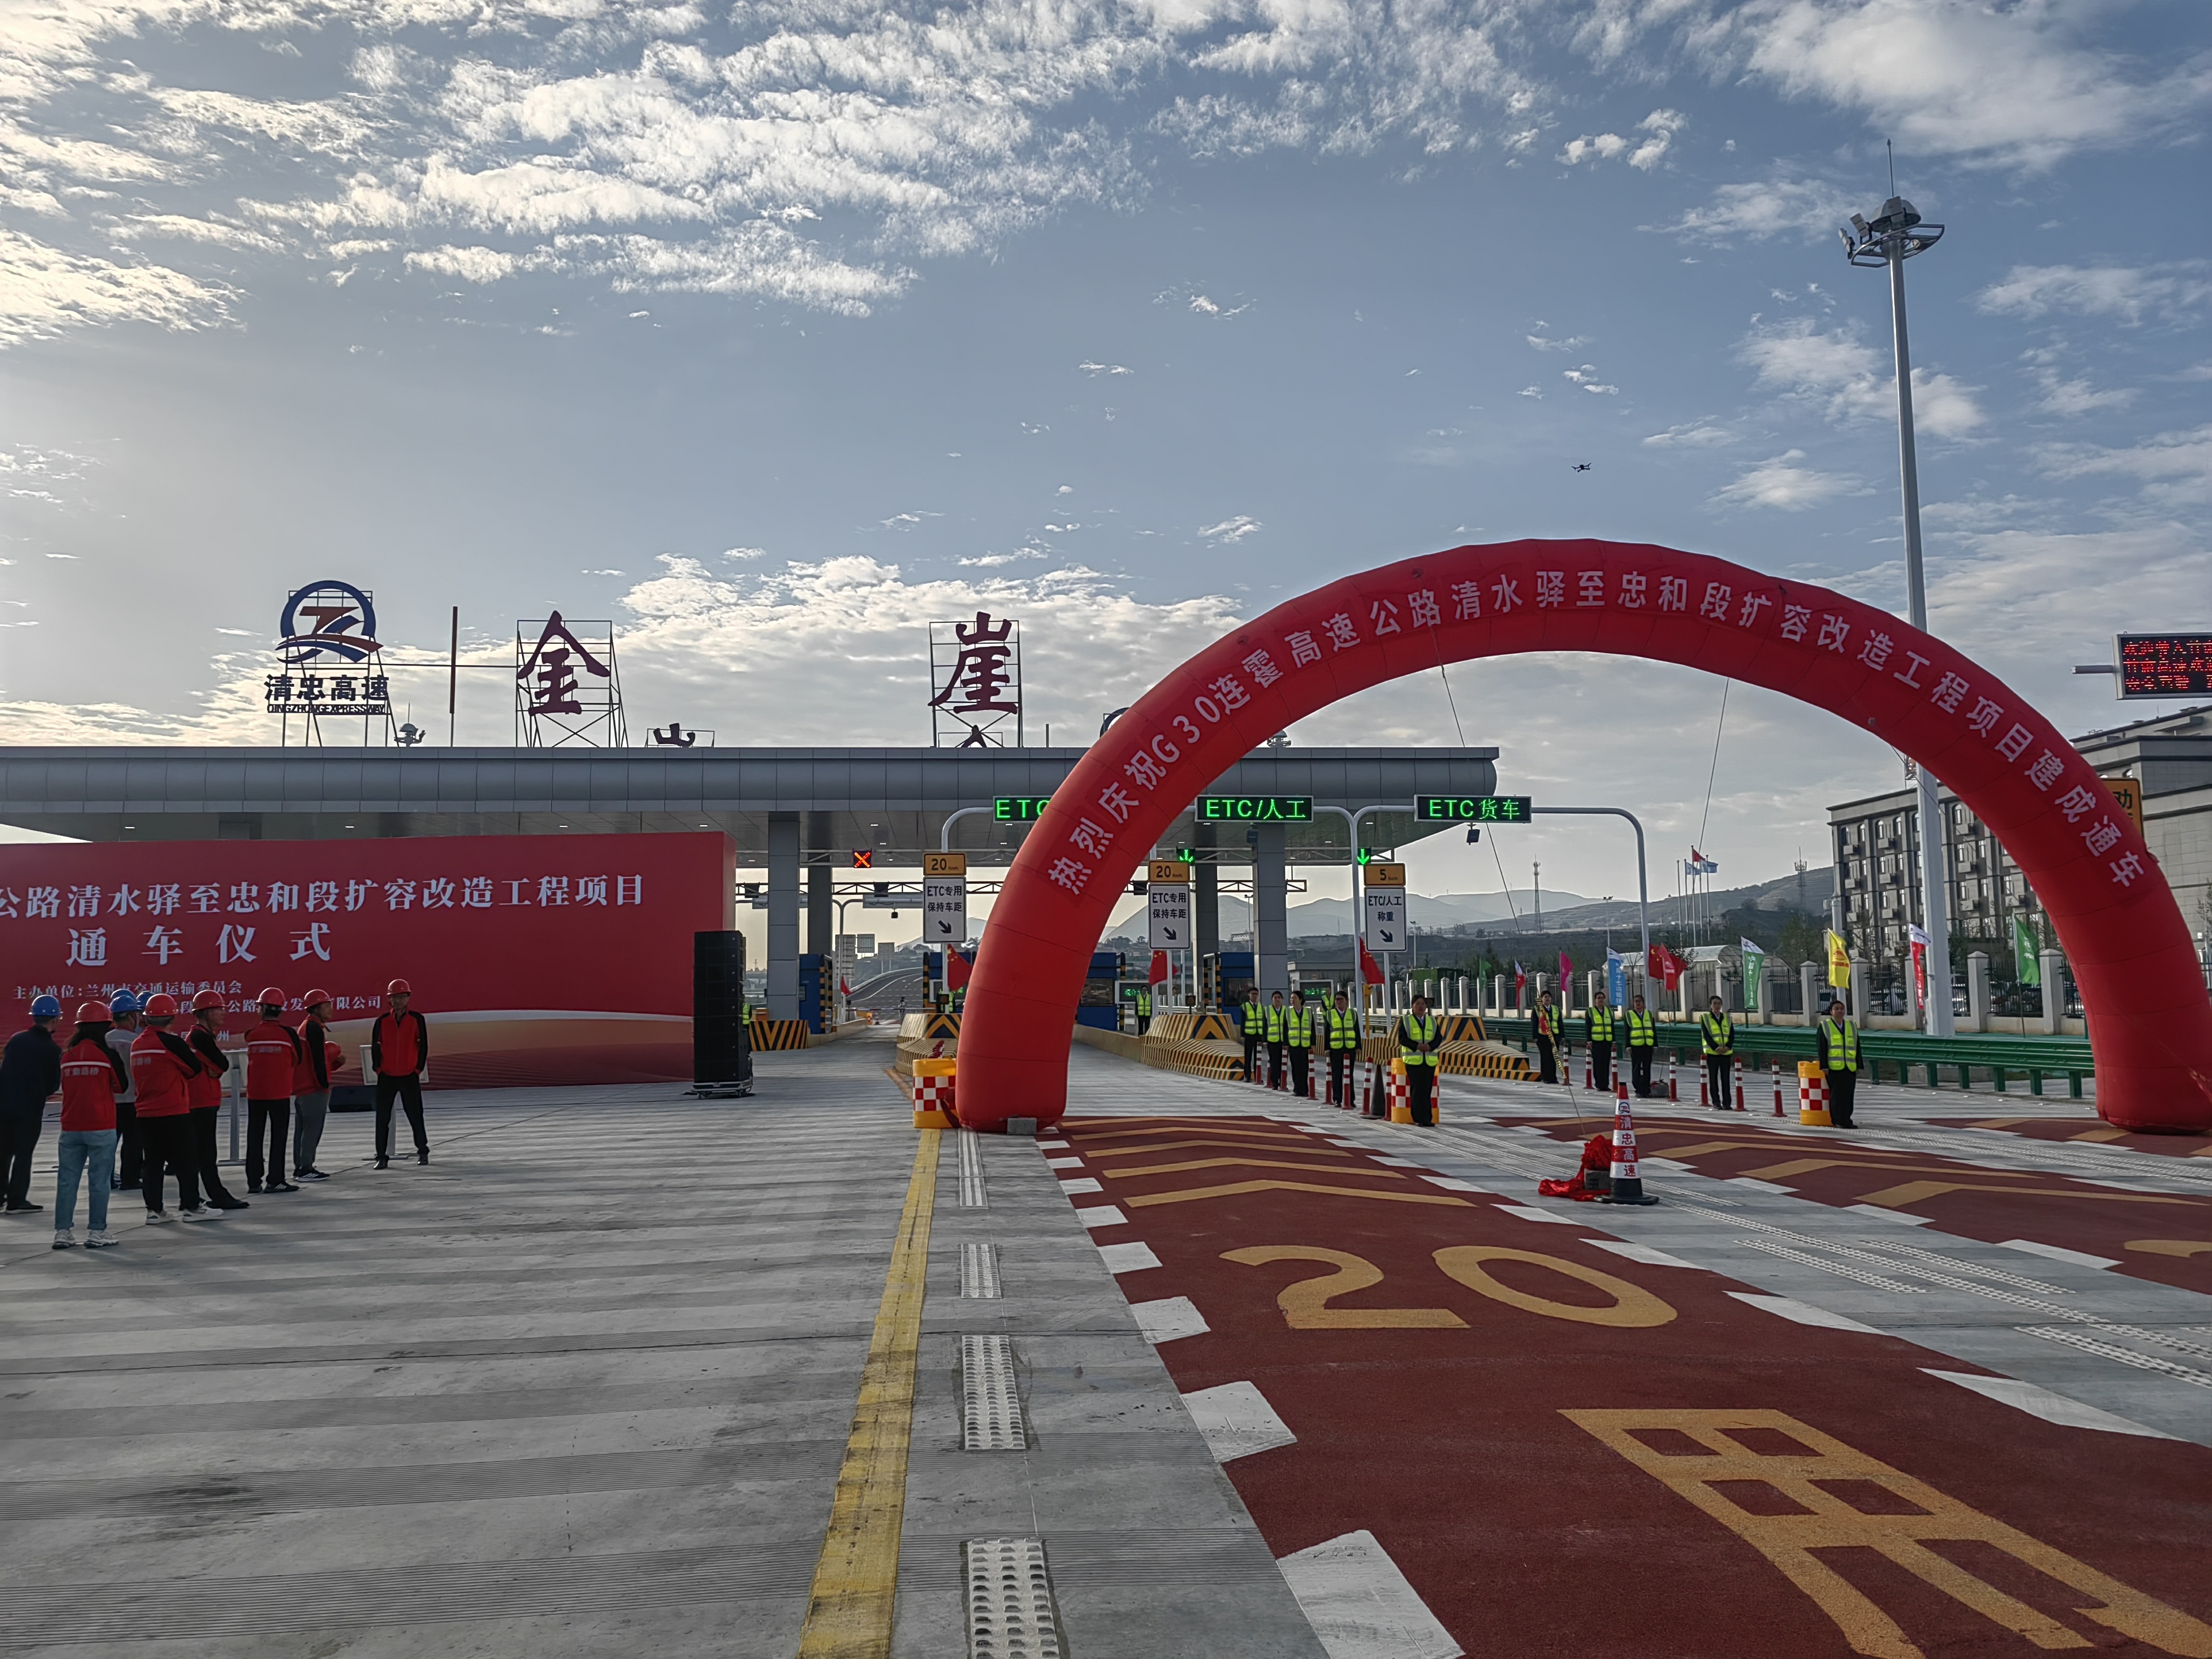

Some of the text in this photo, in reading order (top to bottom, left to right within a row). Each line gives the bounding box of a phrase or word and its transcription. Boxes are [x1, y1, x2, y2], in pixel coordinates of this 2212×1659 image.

[517, 610, 1018, 716] 金 崖
[264, 674, 389, 701] 清忠高速
[1206, 799, 1306, 819] ETC/人工
[1429, 799, 1520, 820] ETC货车
[932, 858, 947, 871] 20
[1156, 865, 1171, 878] 20
[1379, 869, 1387, 881] 5
[0, 874, 643, 918] 公路清水驿至忠和段扩容改造工程项目
[927, 886, 962, 896] ETC专用
[1152, 893, 1186, 903] ETC专用
[1368, 895, 1402, 906] ETC/人工
[928, 902, 963, 912] 保持车距
[1153, 908, 1187, 919] 保持车距
[1377, 911, 1394, 921] 称重
[65, 922, 331, 967] 通车仪式
[1620, 1116, 1636, 1177] 清忠高速
[1219, 1245, 1677, 1328] 20
